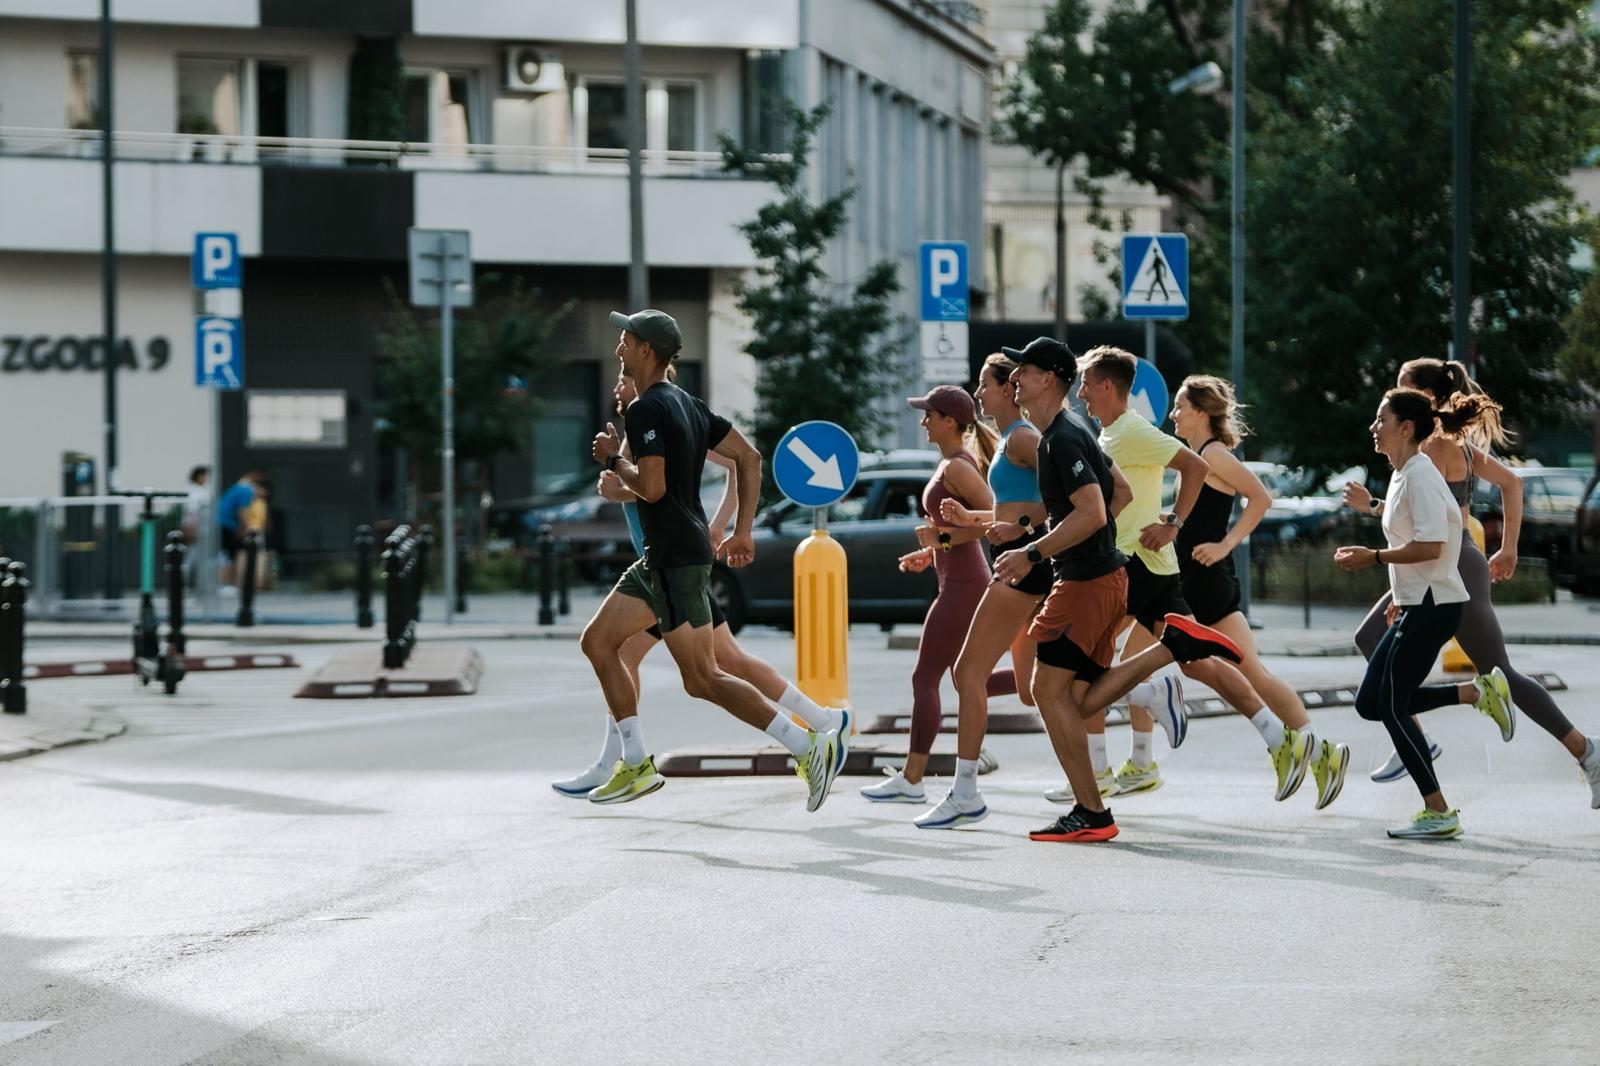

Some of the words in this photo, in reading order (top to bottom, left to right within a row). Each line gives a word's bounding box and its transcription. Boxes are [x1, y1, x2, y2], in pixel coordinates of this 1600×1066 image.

[203, 237, 232, 280] P
[931, 249, 959, 298] P
[2, 335, 138, 371] ZGODA
[148, 335, 170, 370] 9
